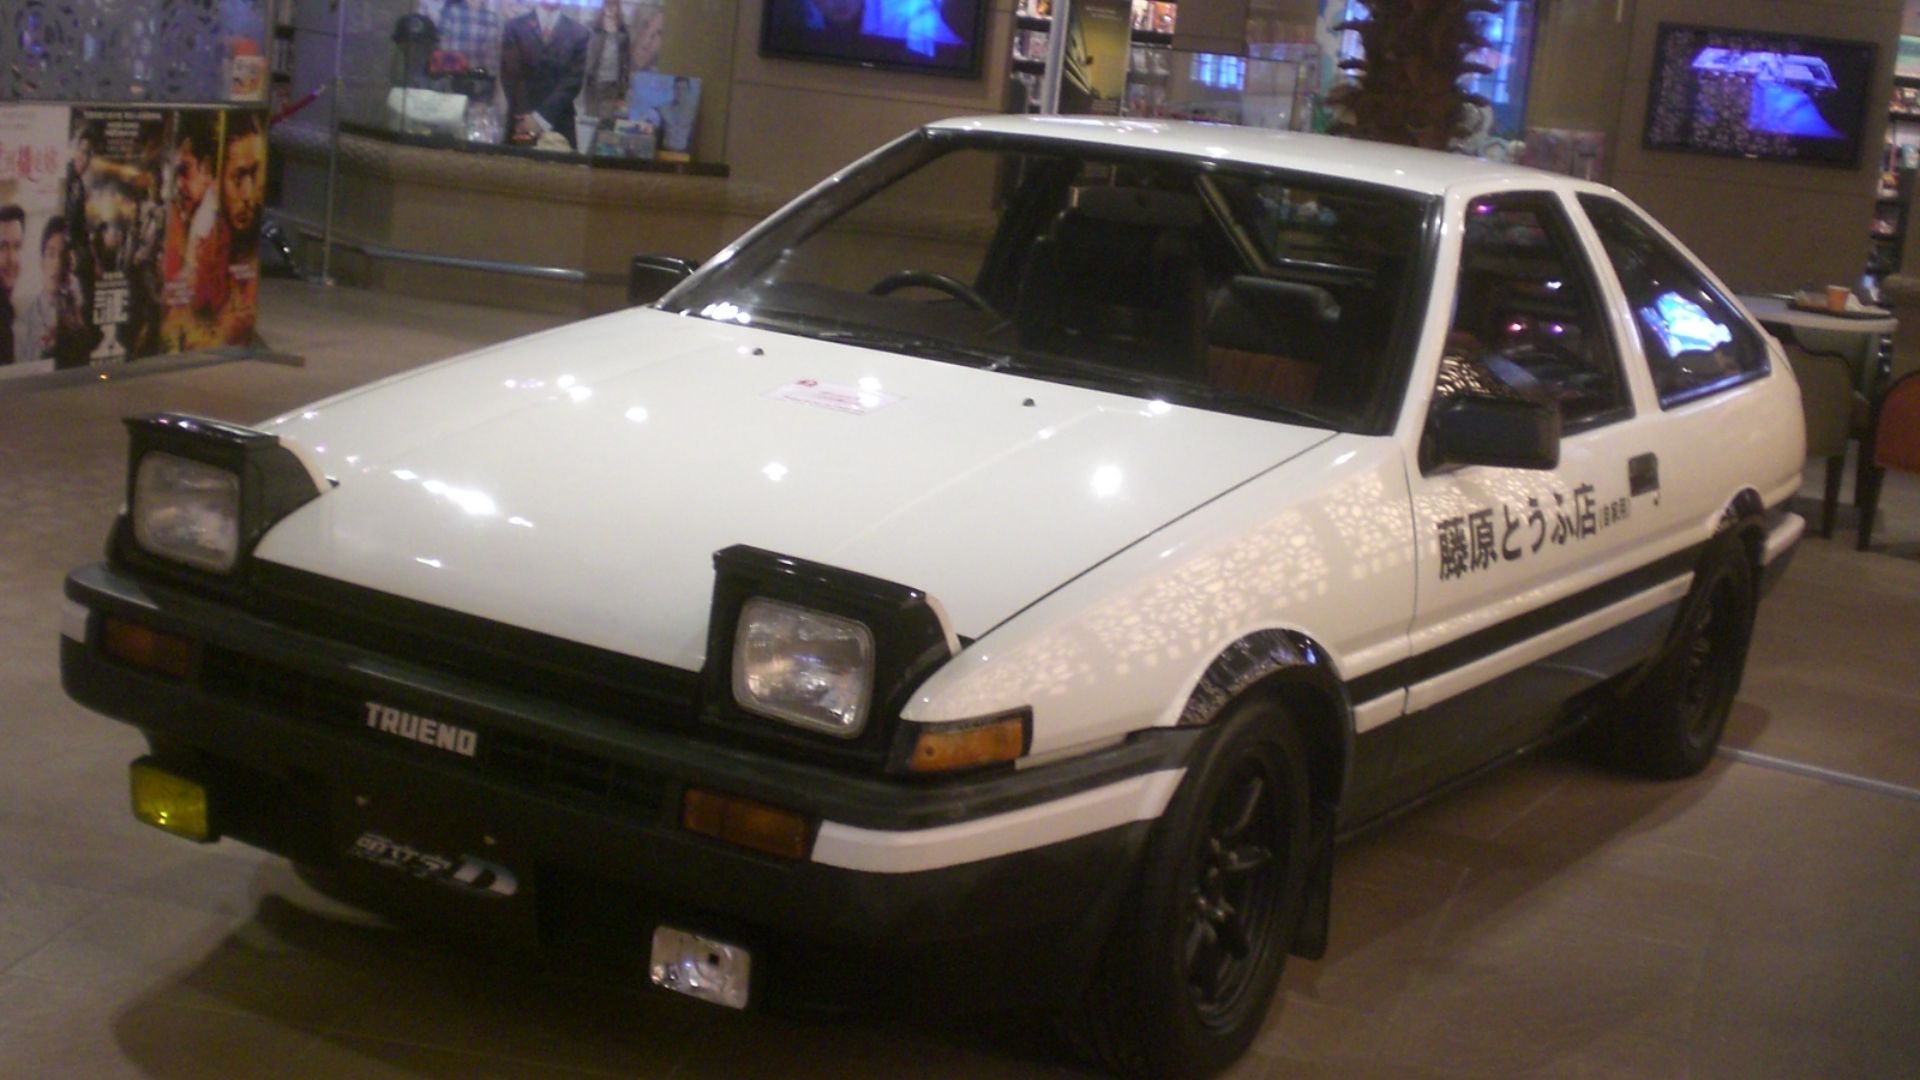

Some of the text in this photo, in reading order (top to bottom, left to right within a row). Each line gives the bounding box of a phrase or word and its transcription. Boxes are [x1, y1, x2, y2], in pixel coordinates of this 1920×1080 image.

[1437, 482, 1597, 582] 藤原とうふ店
[364, 701, 479, 758] TRUENO
